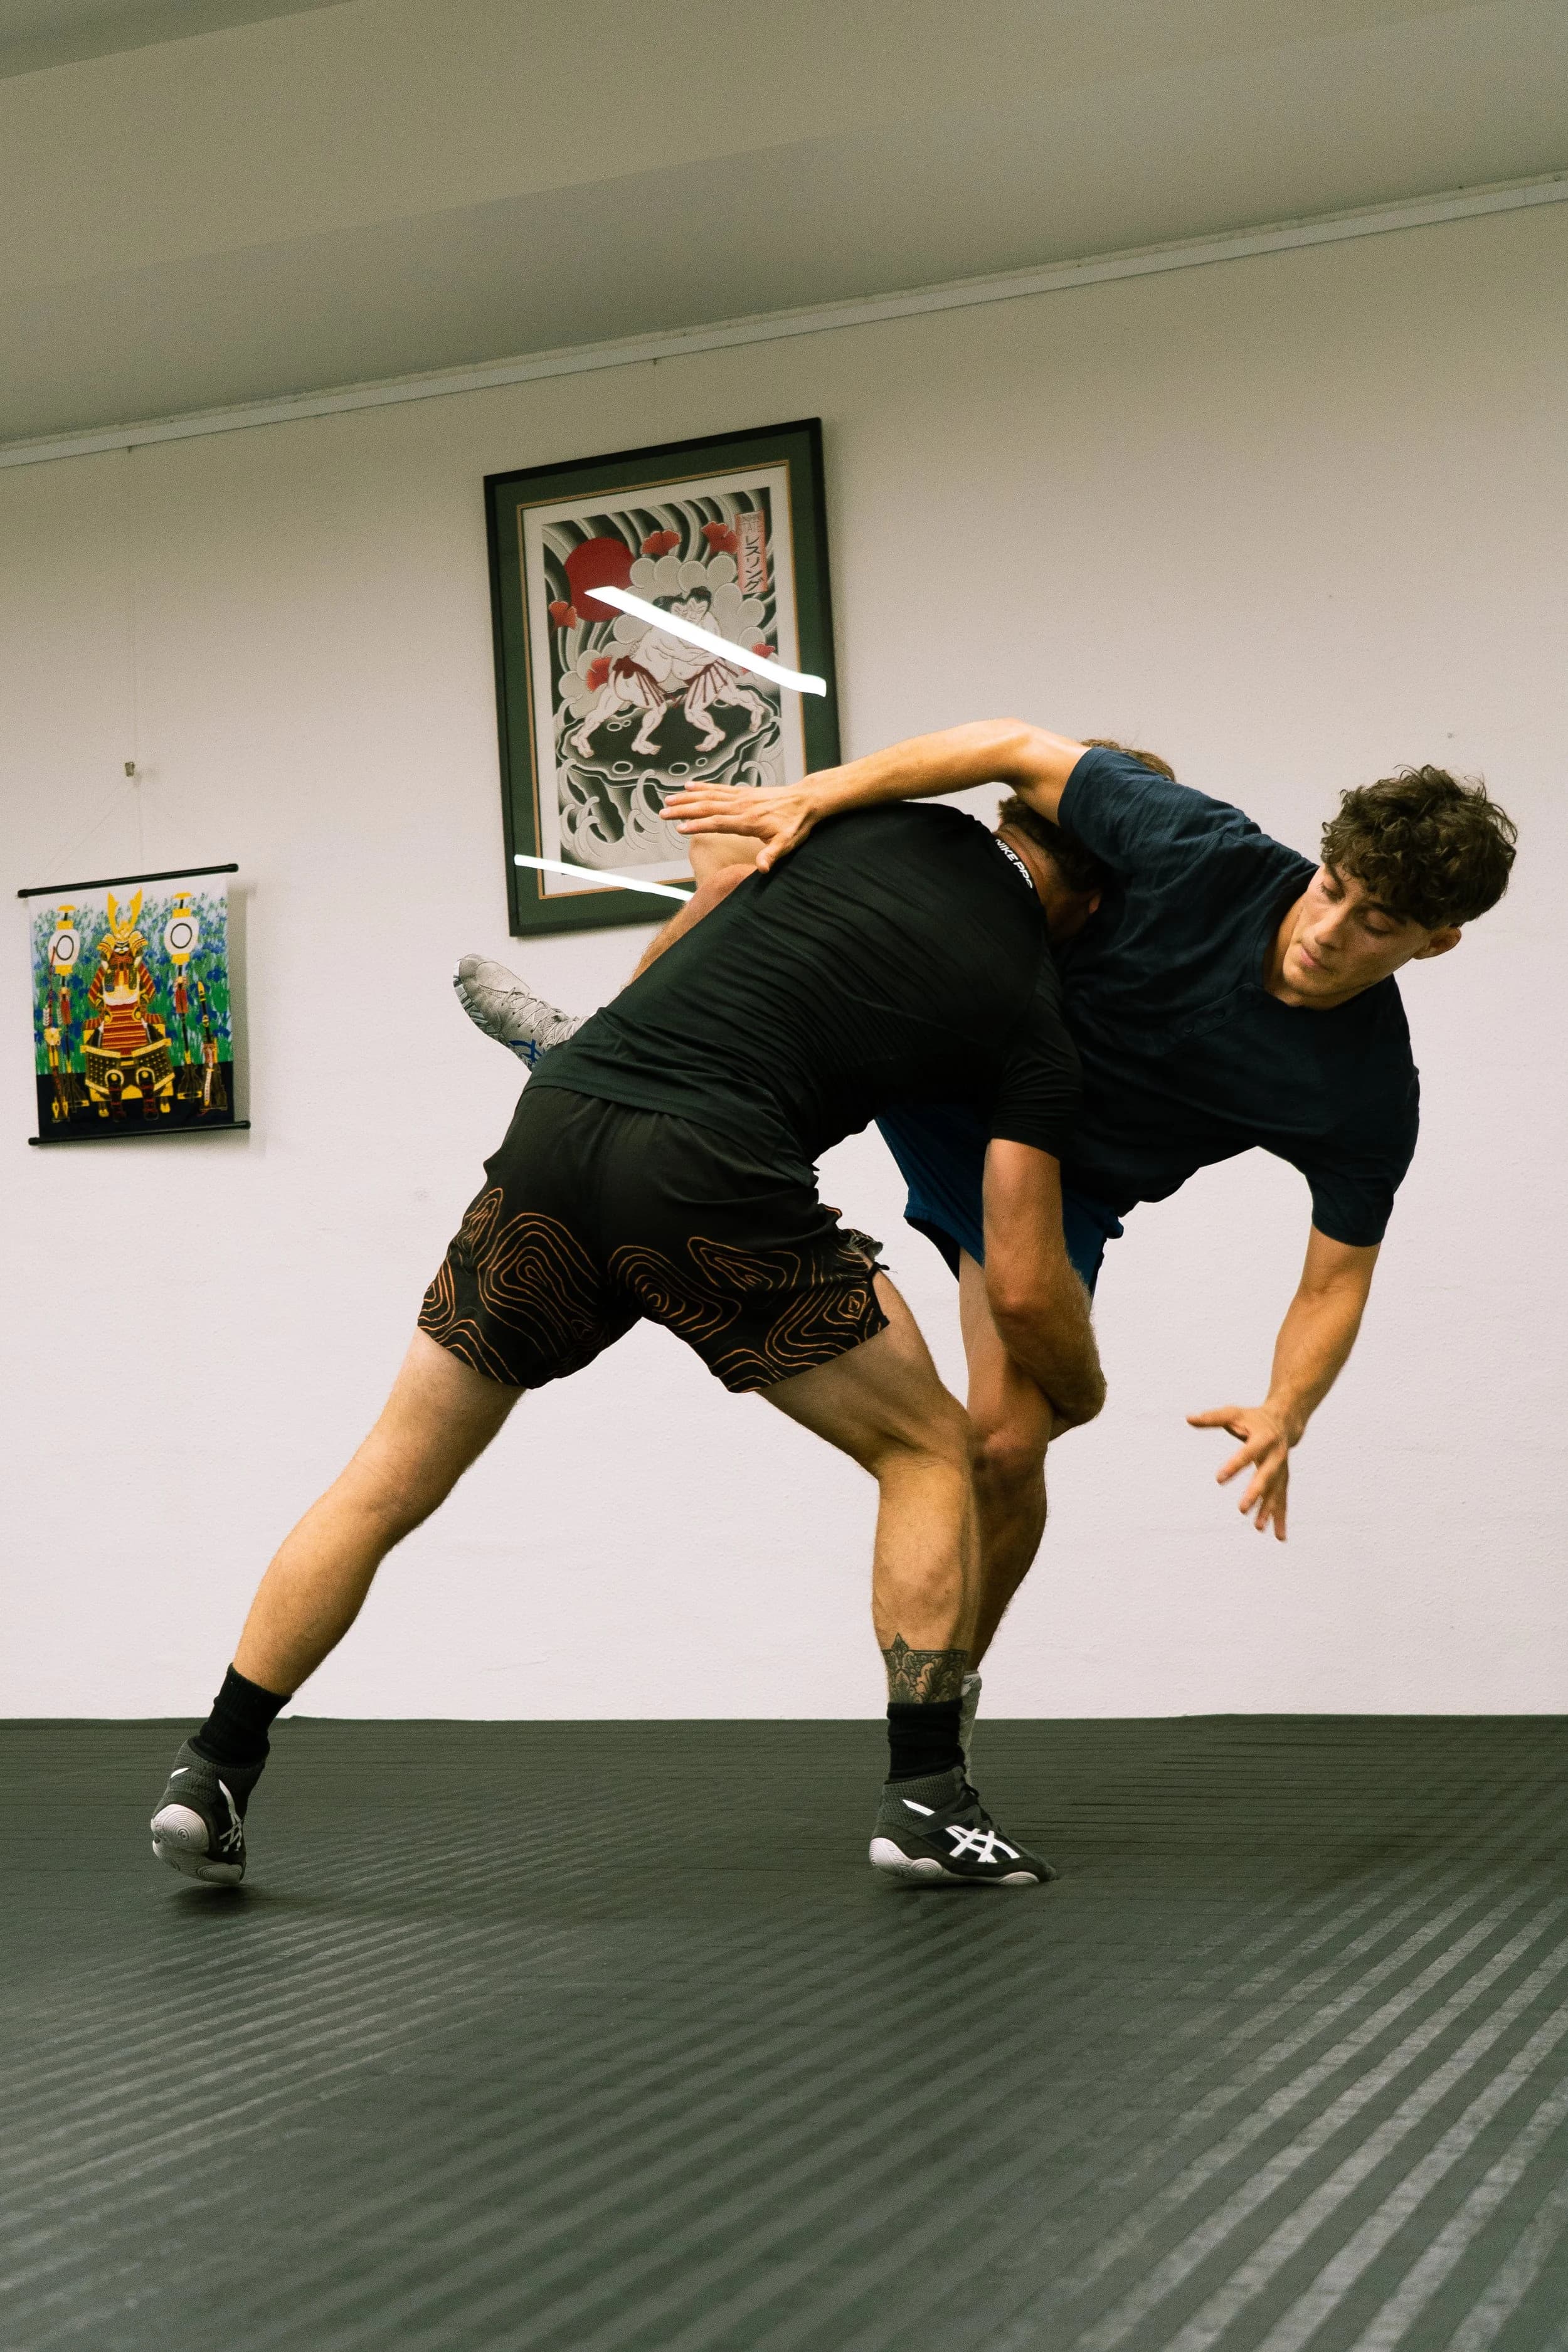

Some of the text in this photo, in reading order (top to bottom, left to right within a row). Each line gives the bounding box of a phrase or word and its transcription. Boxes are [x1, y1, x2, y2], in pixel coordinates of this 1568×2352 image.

[743, 535, 763, 592] レスリング
[995, 839, 1019, 861] NIKE
